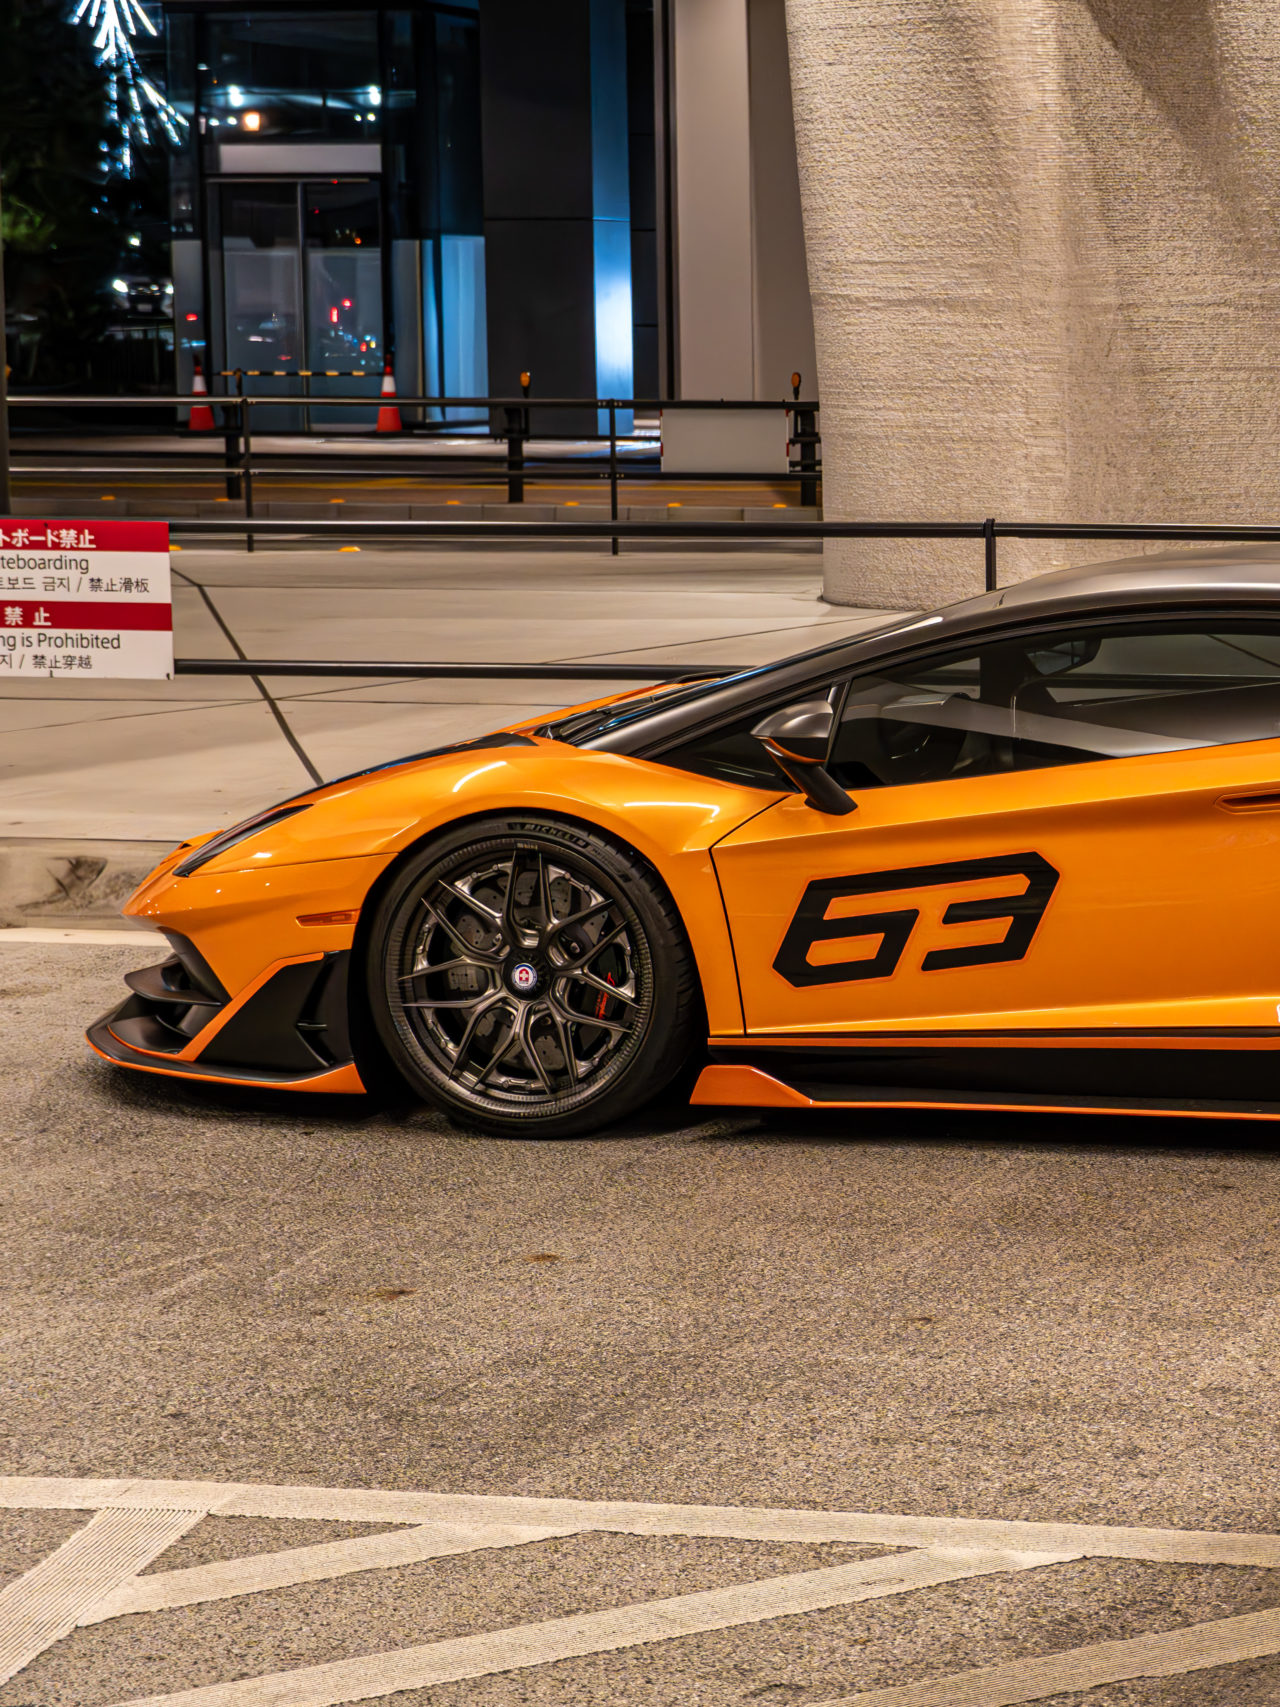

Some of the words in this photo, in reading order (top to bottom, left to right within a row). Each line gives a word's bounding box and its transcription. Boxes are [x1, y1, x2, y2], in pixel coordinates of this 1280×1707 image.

[0, 528, 97, 548] トボード禁止
[0, 554, 90, 574] teboarding
[42, 576, 70, 592] 금지
[77, 577, 82, 592] /
[88, 577, 150, 593] 禁止滑板
[21, 632, 33, 647] is
[38, 633, 121, 649] Prohibited
[32, 655, 93, 670] 禁止穿越
[522, 823, 588, 848] MICHELIN
[772, 851, 1060, 988] 63
